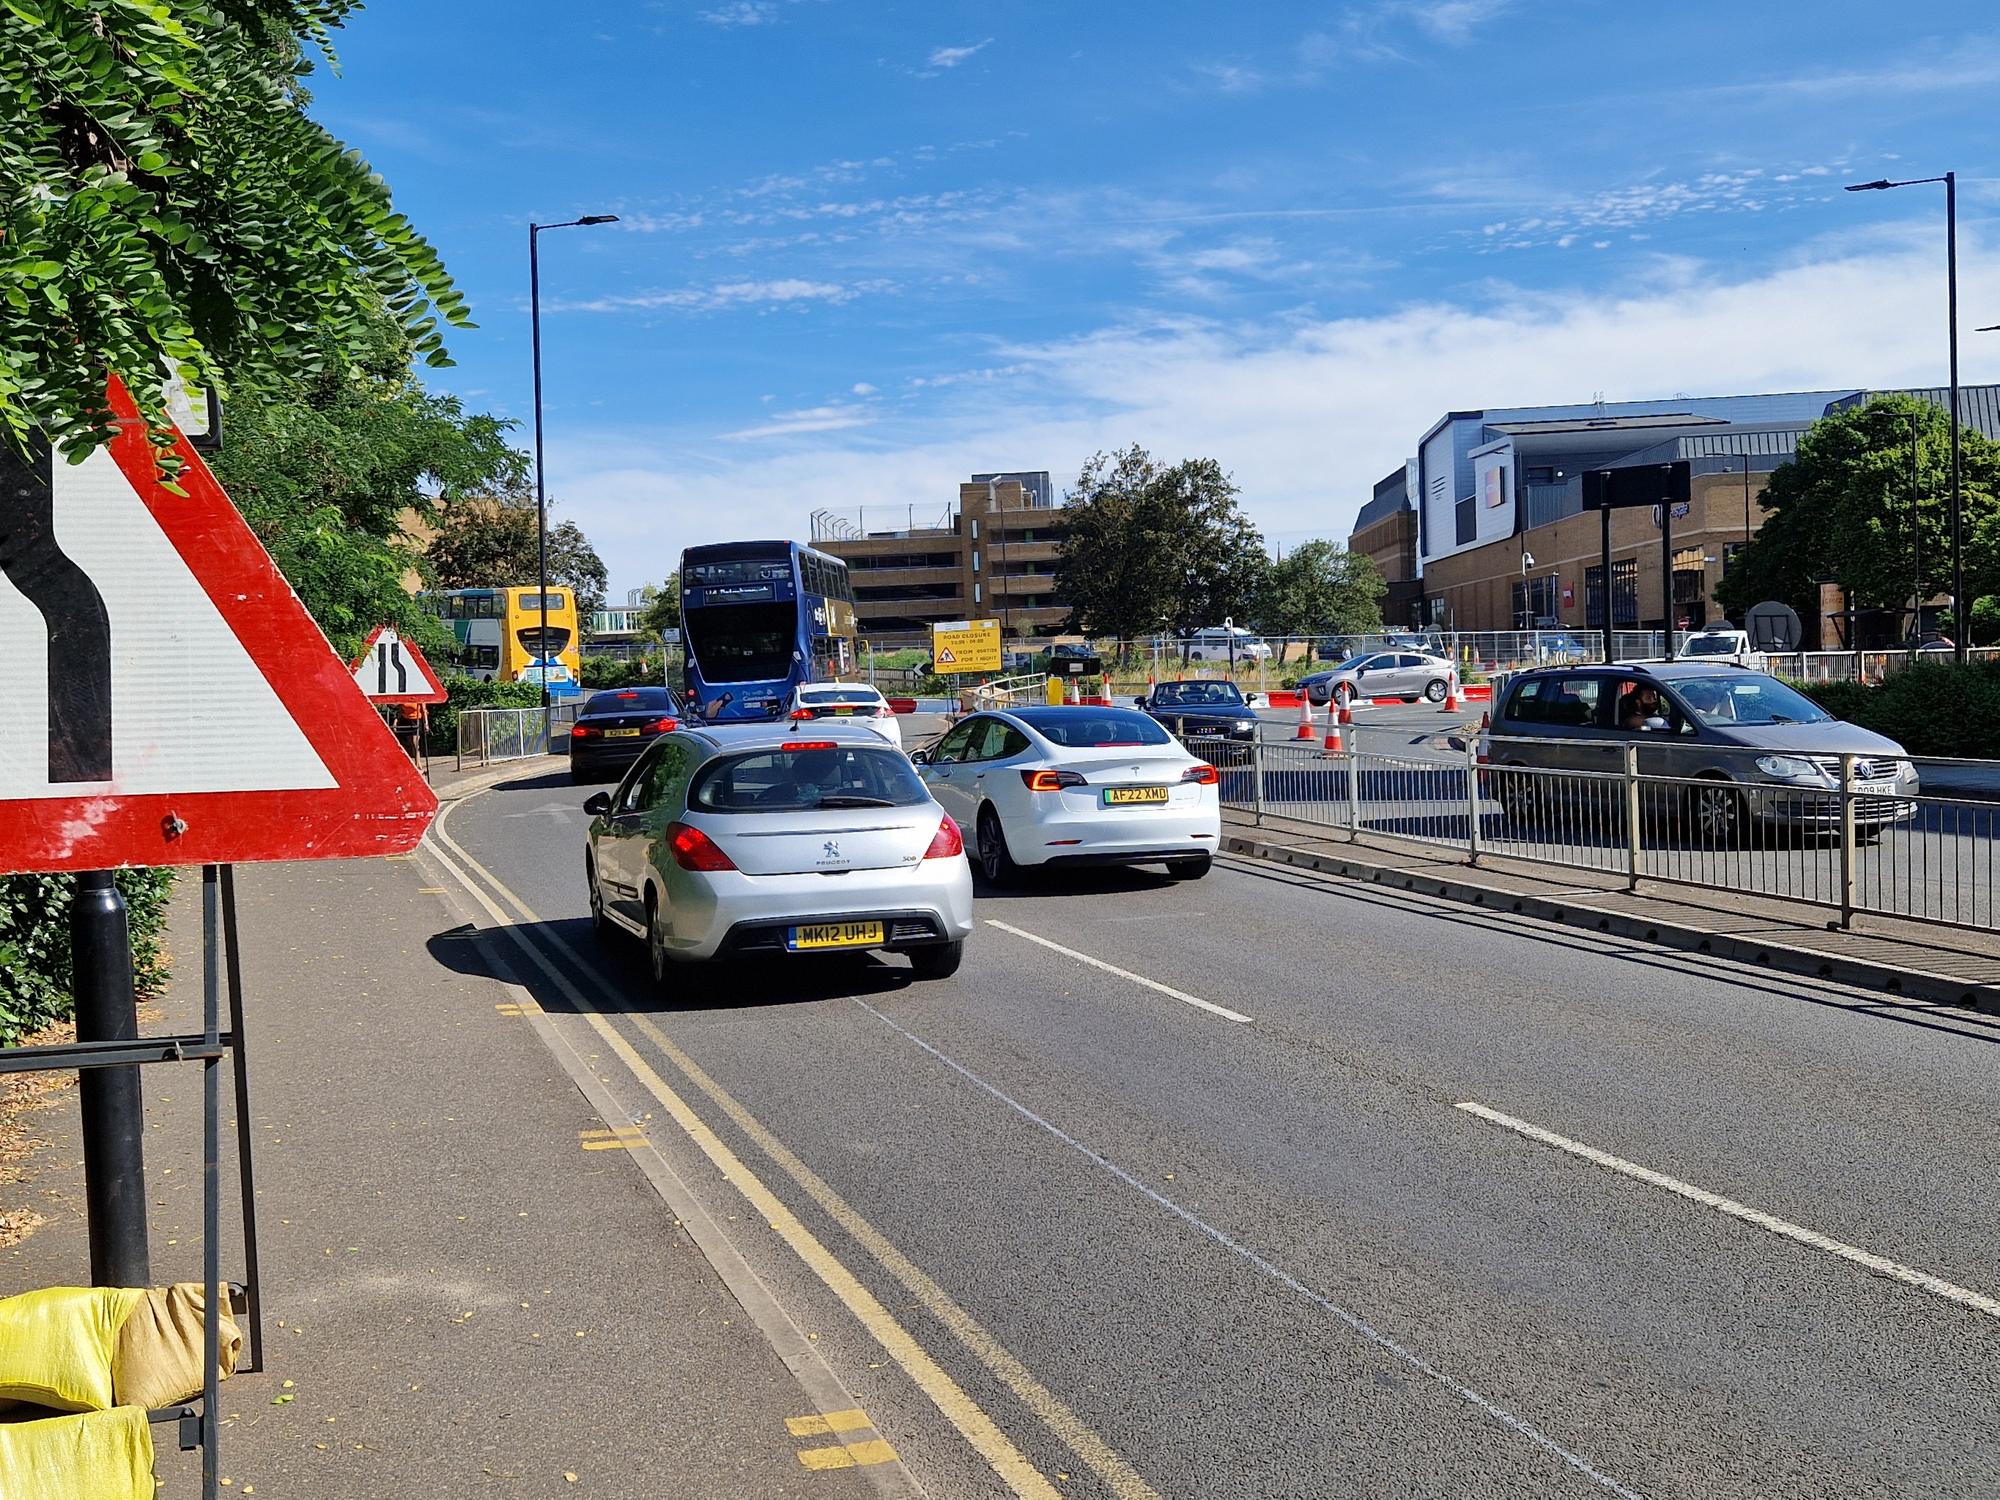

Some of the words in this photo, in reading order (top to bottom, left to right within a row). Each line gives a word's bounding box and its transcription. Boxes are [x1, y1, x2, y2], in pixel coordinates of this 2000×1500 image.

[1112, 789, 1142, 801] AF22
[1145, 788, 1166, 800] XMD
[1876, 785, 1892, 794] HKE
[804, 926, 840, 943] MK12
[845, 923, 877, 941] UHJ
